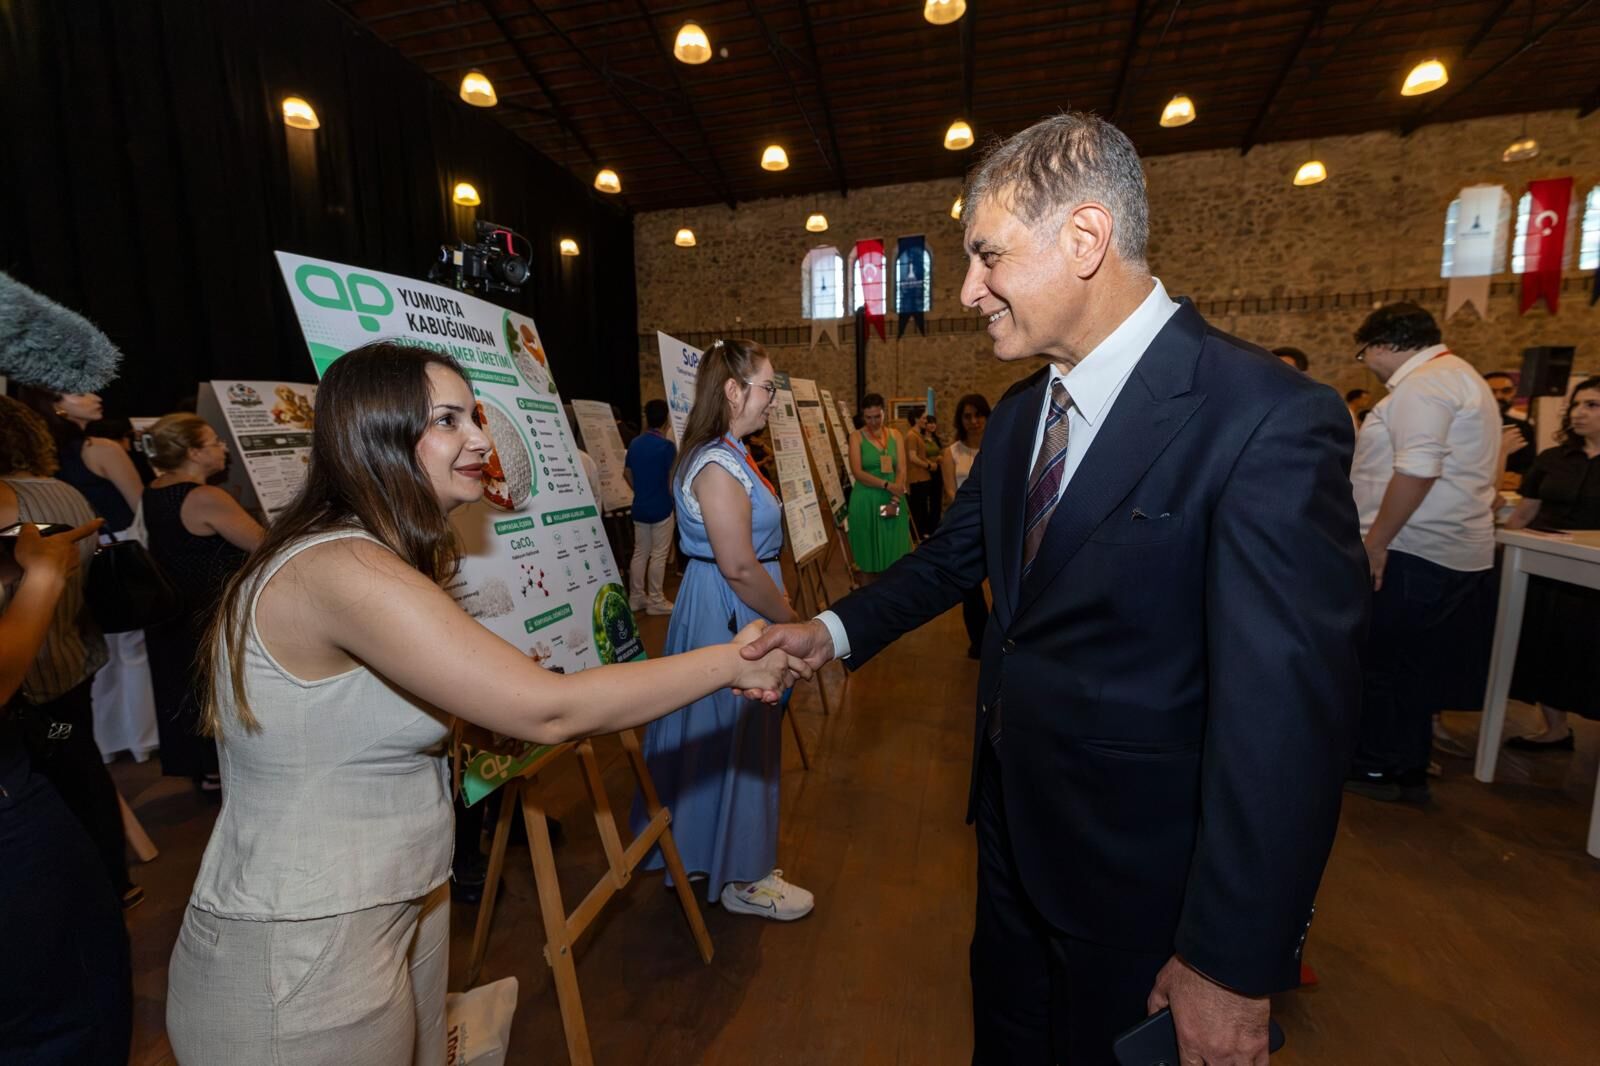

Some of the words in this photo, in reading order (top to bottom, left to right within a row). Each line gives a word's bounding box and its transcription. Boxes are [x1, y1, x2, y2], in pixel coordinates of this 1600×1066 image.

[397, 287, 465, 318] YUMURTA
[406, 312, 496, 347] KABUĞUNDAN
[477, 347, 512, 369] ÜRETİMİ
